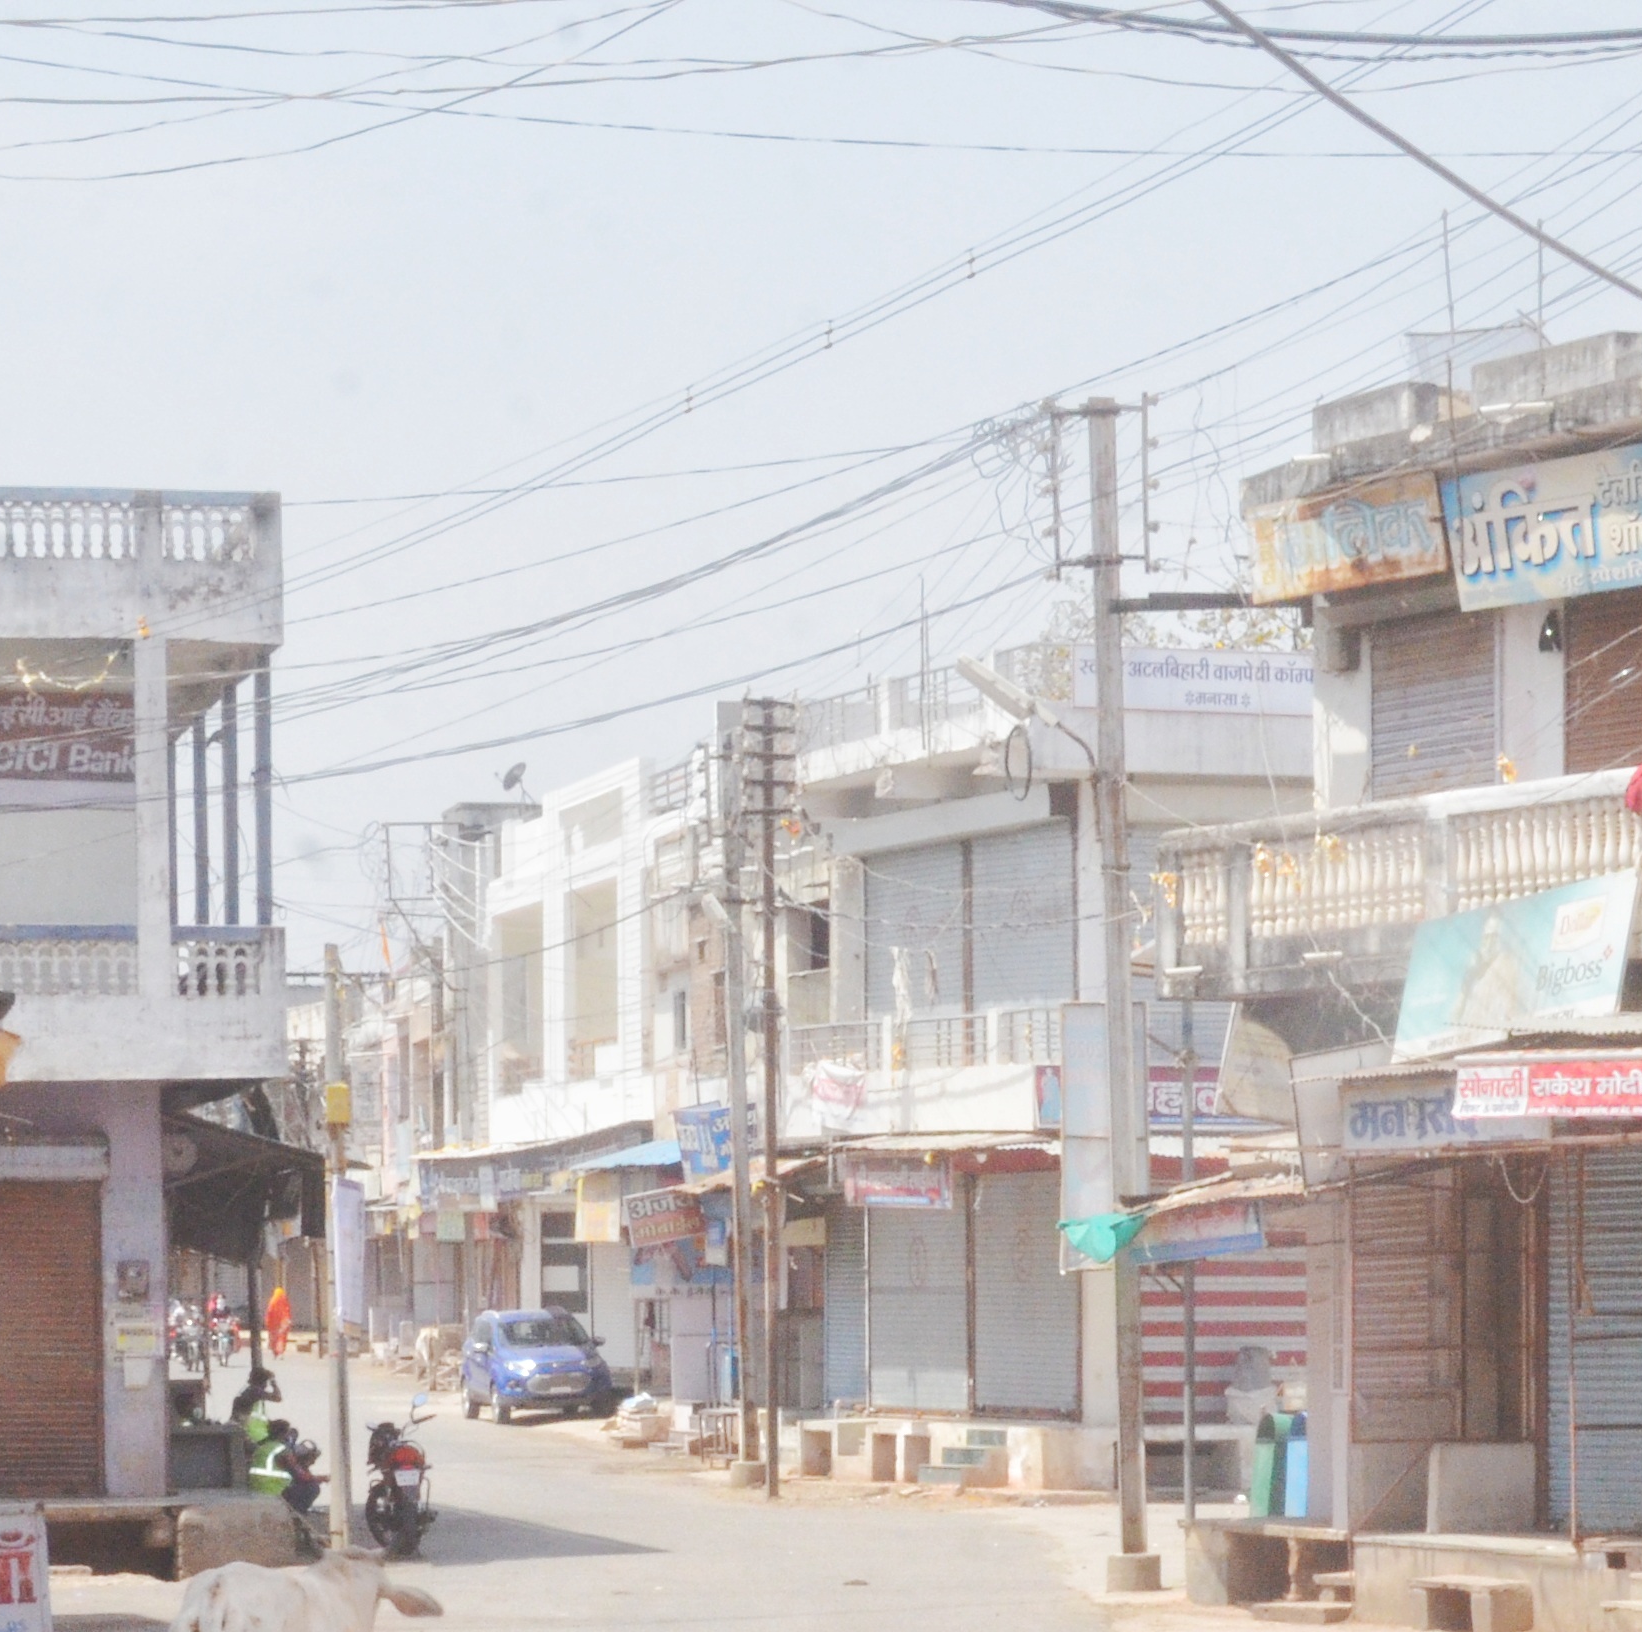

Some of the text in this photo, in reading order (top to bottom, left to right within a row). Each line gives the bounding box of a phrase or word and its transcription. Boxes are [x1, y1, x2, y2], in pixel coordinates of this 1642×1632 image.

[1453, 480, 1599, 578] अंकित
[1127, 654, 1209, 681] अटलबिहारी
[1213, 660, 1270, 684] वाजपेयी
[1194, 691, 1238, 707] मनासा
[68, 743, 136, 773] Bank
[1535, 955, 1604, 997] Bigboss
[1458, 1066, 1525, 1100] सोनाली
[1530, 1069, 1590, 1099] राकेश
